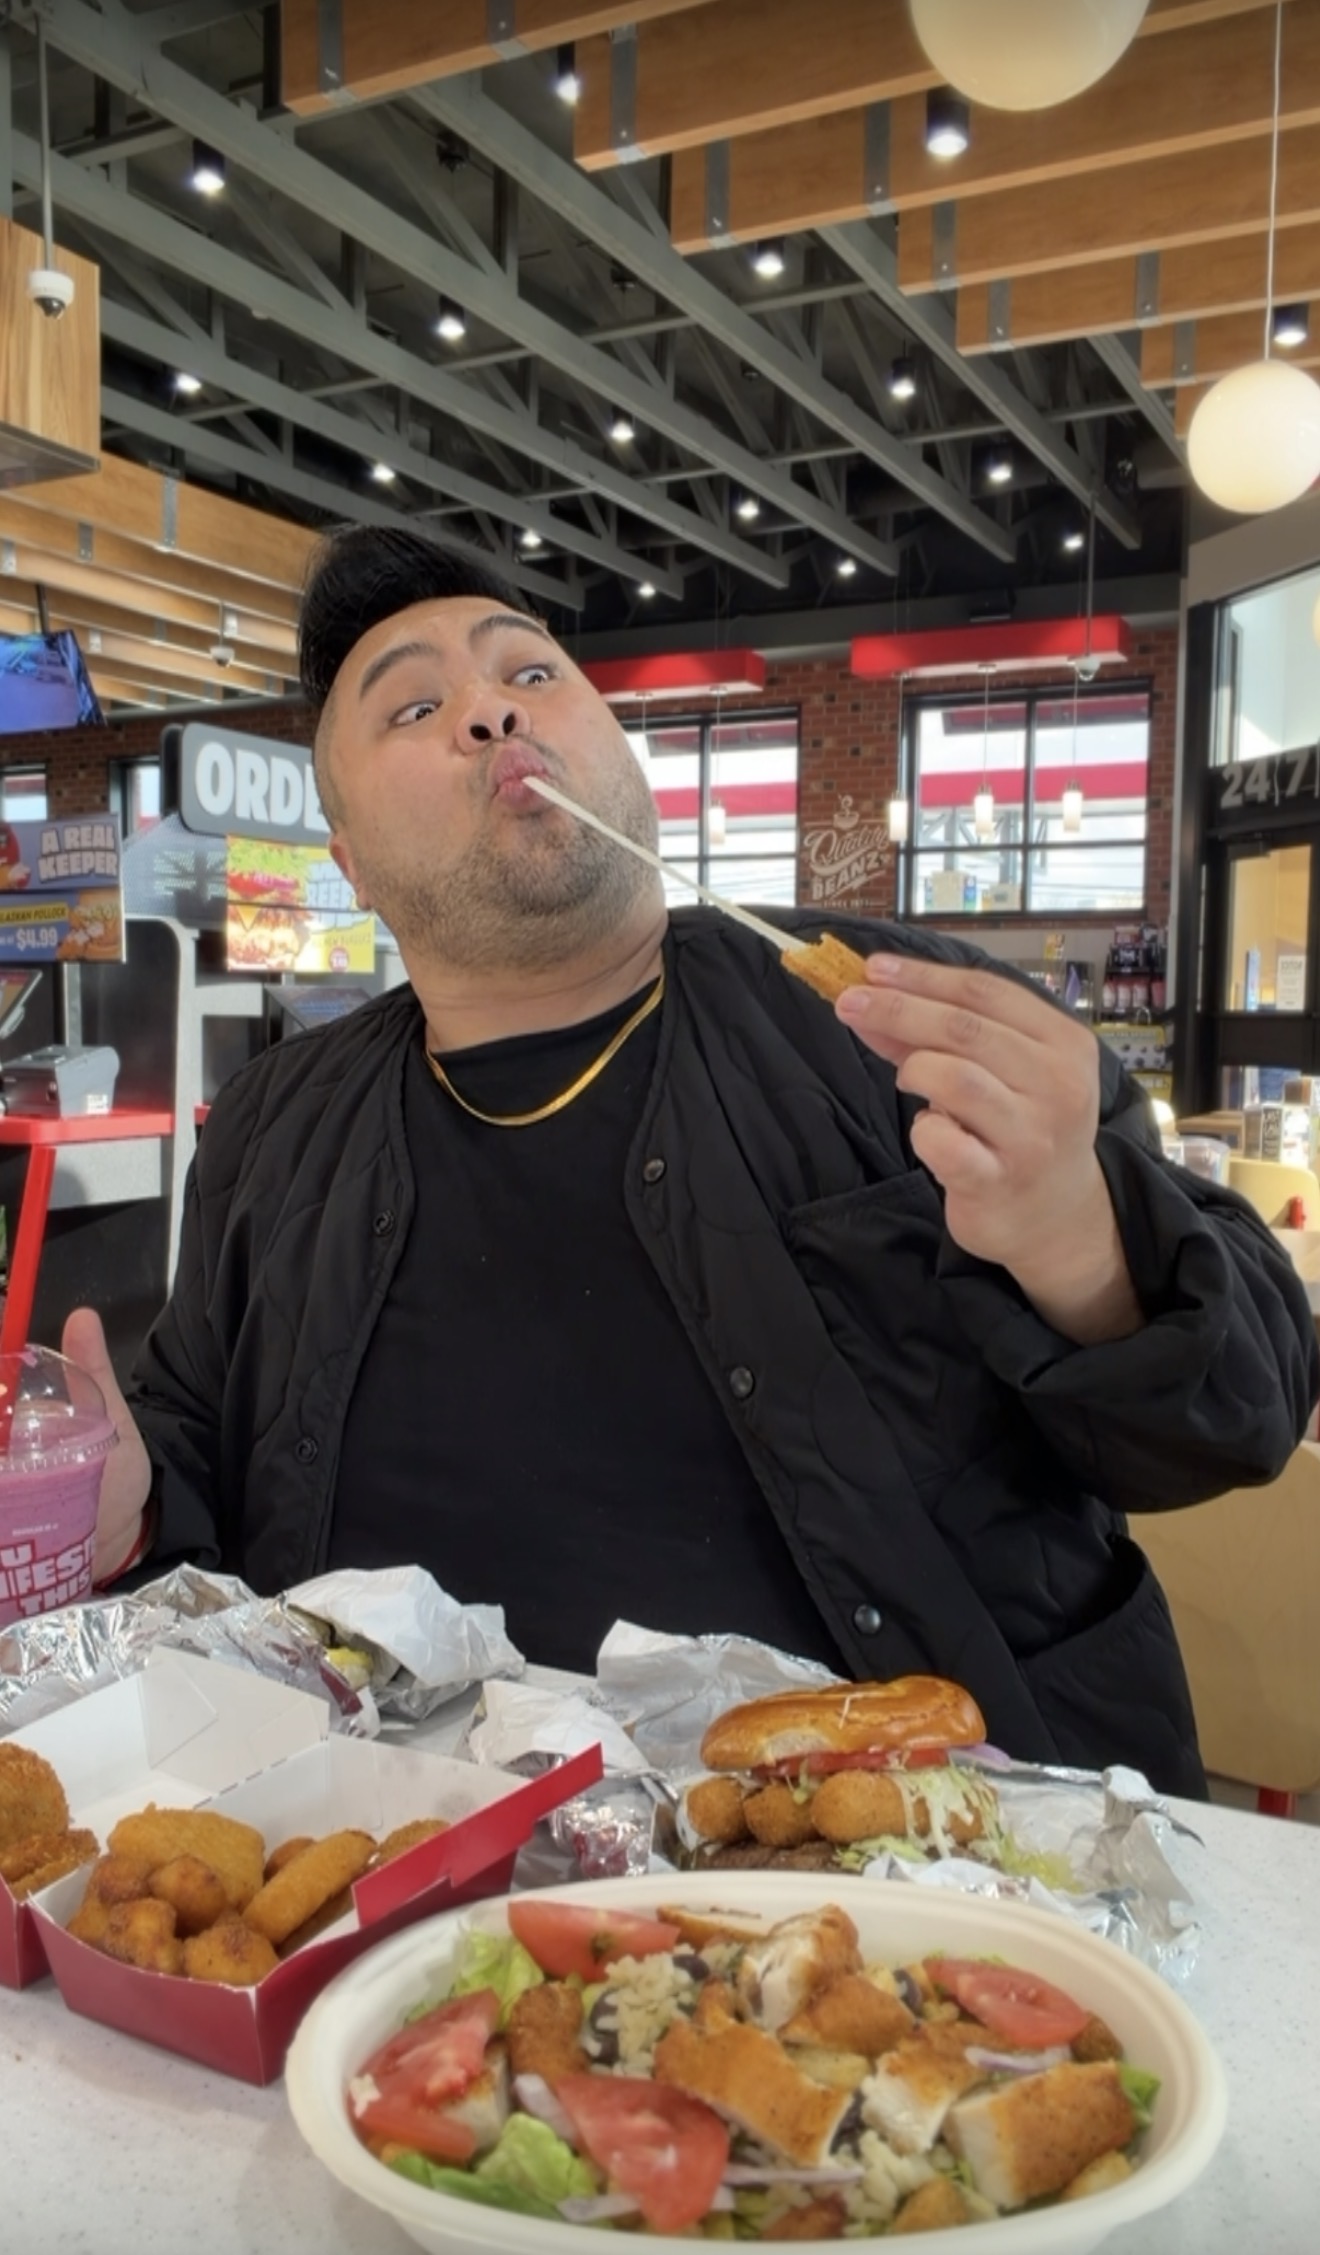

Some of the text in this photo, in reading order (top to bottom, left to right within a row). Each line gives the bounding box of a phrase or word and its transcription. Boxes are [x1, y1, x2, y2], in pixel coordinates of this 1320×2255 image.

[41, 825, 115, 855] A REAL
[803, 825, 889, 866] Quality
[38, 851, 118, 881] KEEPER
[812, 851, 880, 900] BEANZ
[33, 906, 67, 920] POLLOCK
[16, 927, 58, 951] $4.99
[20, 1565, 91, 1616] THIS
